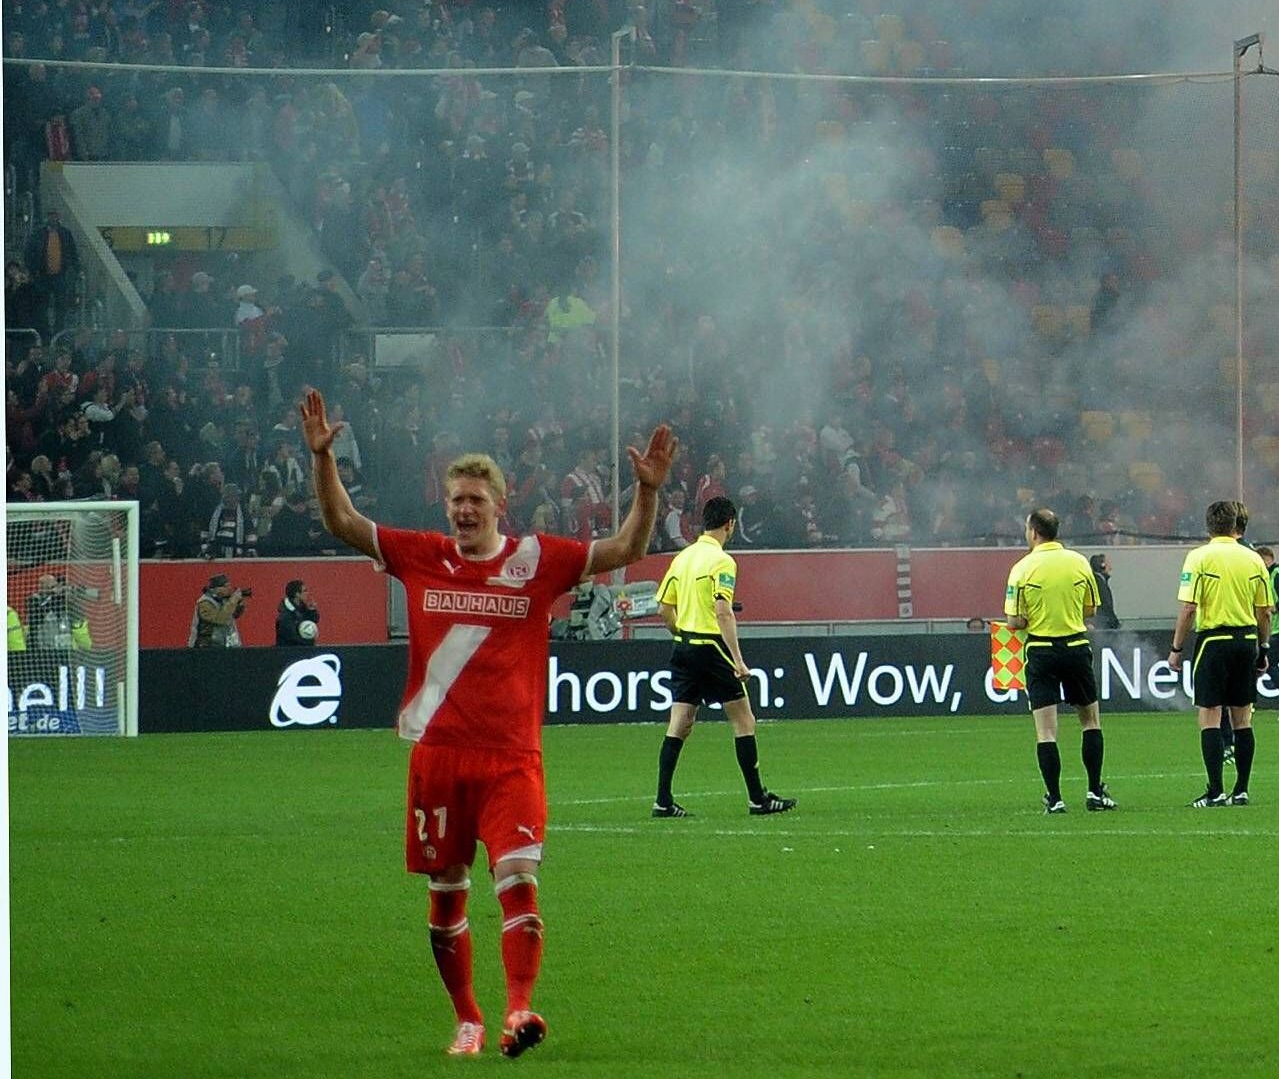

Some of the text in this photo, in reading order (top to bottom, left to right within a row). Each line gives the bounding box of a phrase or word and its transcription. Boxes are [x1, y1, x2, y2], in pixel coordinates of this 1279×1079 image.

[425, 591, 528, 615] BAUHAUS
[805, 652, 961, 712] Wow,
[414, 807, 447, 841] 21
